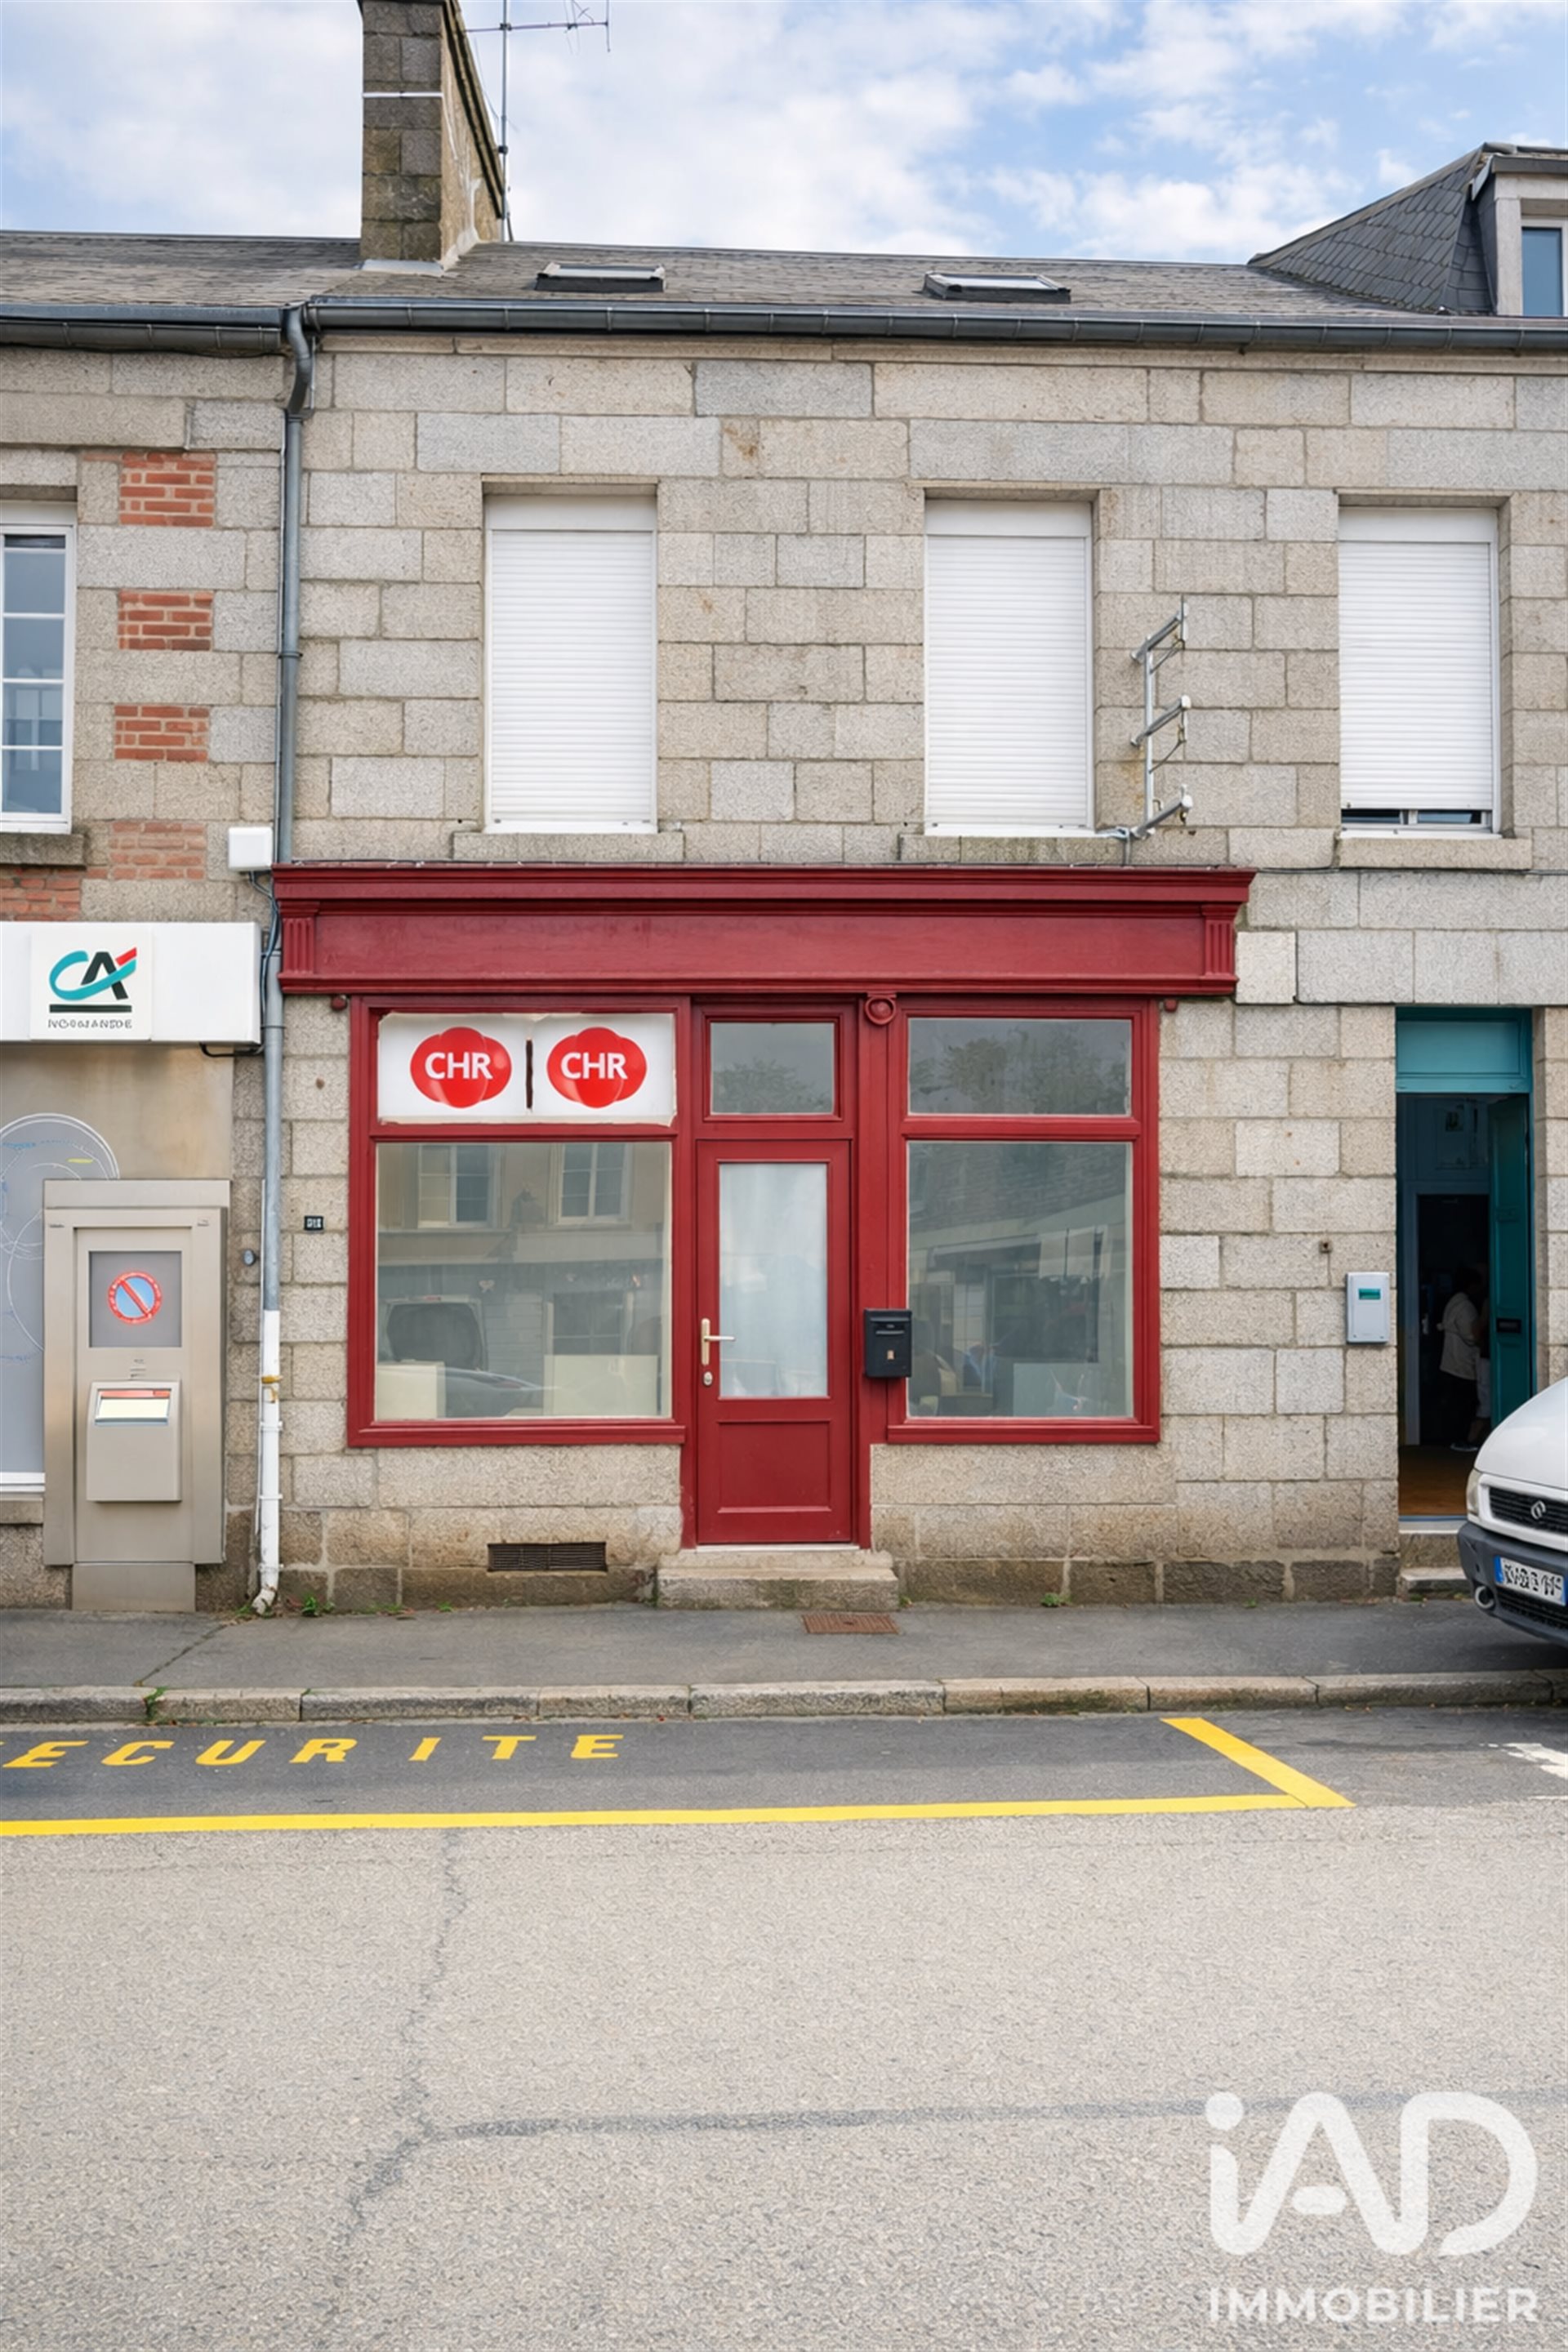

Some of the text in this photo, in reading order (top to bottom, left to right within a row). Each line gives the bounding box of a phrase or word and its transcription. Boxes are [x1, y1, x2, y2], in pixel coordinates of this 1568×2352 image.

[425, 1051, 493, 1080] CHR
[560, 1052, 628, 1080] CHR
[0, 1734, 624, 1769] ECURITE
